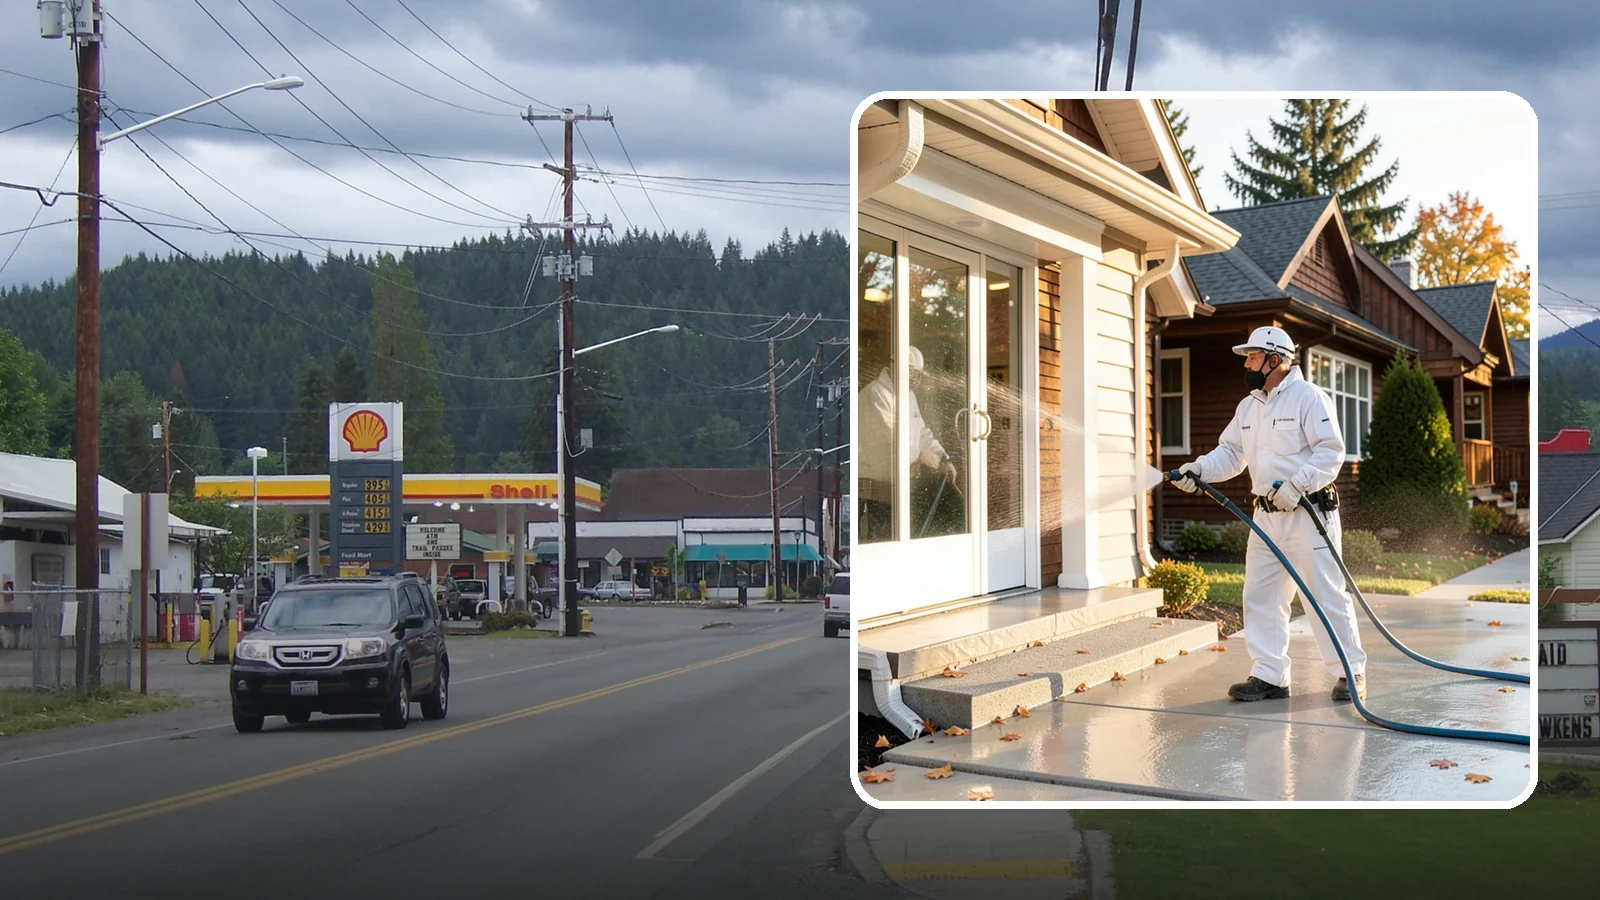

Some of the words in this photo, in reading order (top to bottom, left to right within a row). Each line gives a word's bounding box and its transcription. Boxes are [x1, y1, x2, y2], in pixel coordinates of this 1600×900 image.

[365, 480, 383, 490] 395
[490, 484, 547, 499] Shell
[365, 494, 383, 504] 405
[365, 508, 383, 518] 415
[365, 522, 383, 532] 429
[1538, 642, 1567, 665] AID
[1538, 715, 1592, 738] WKENS
